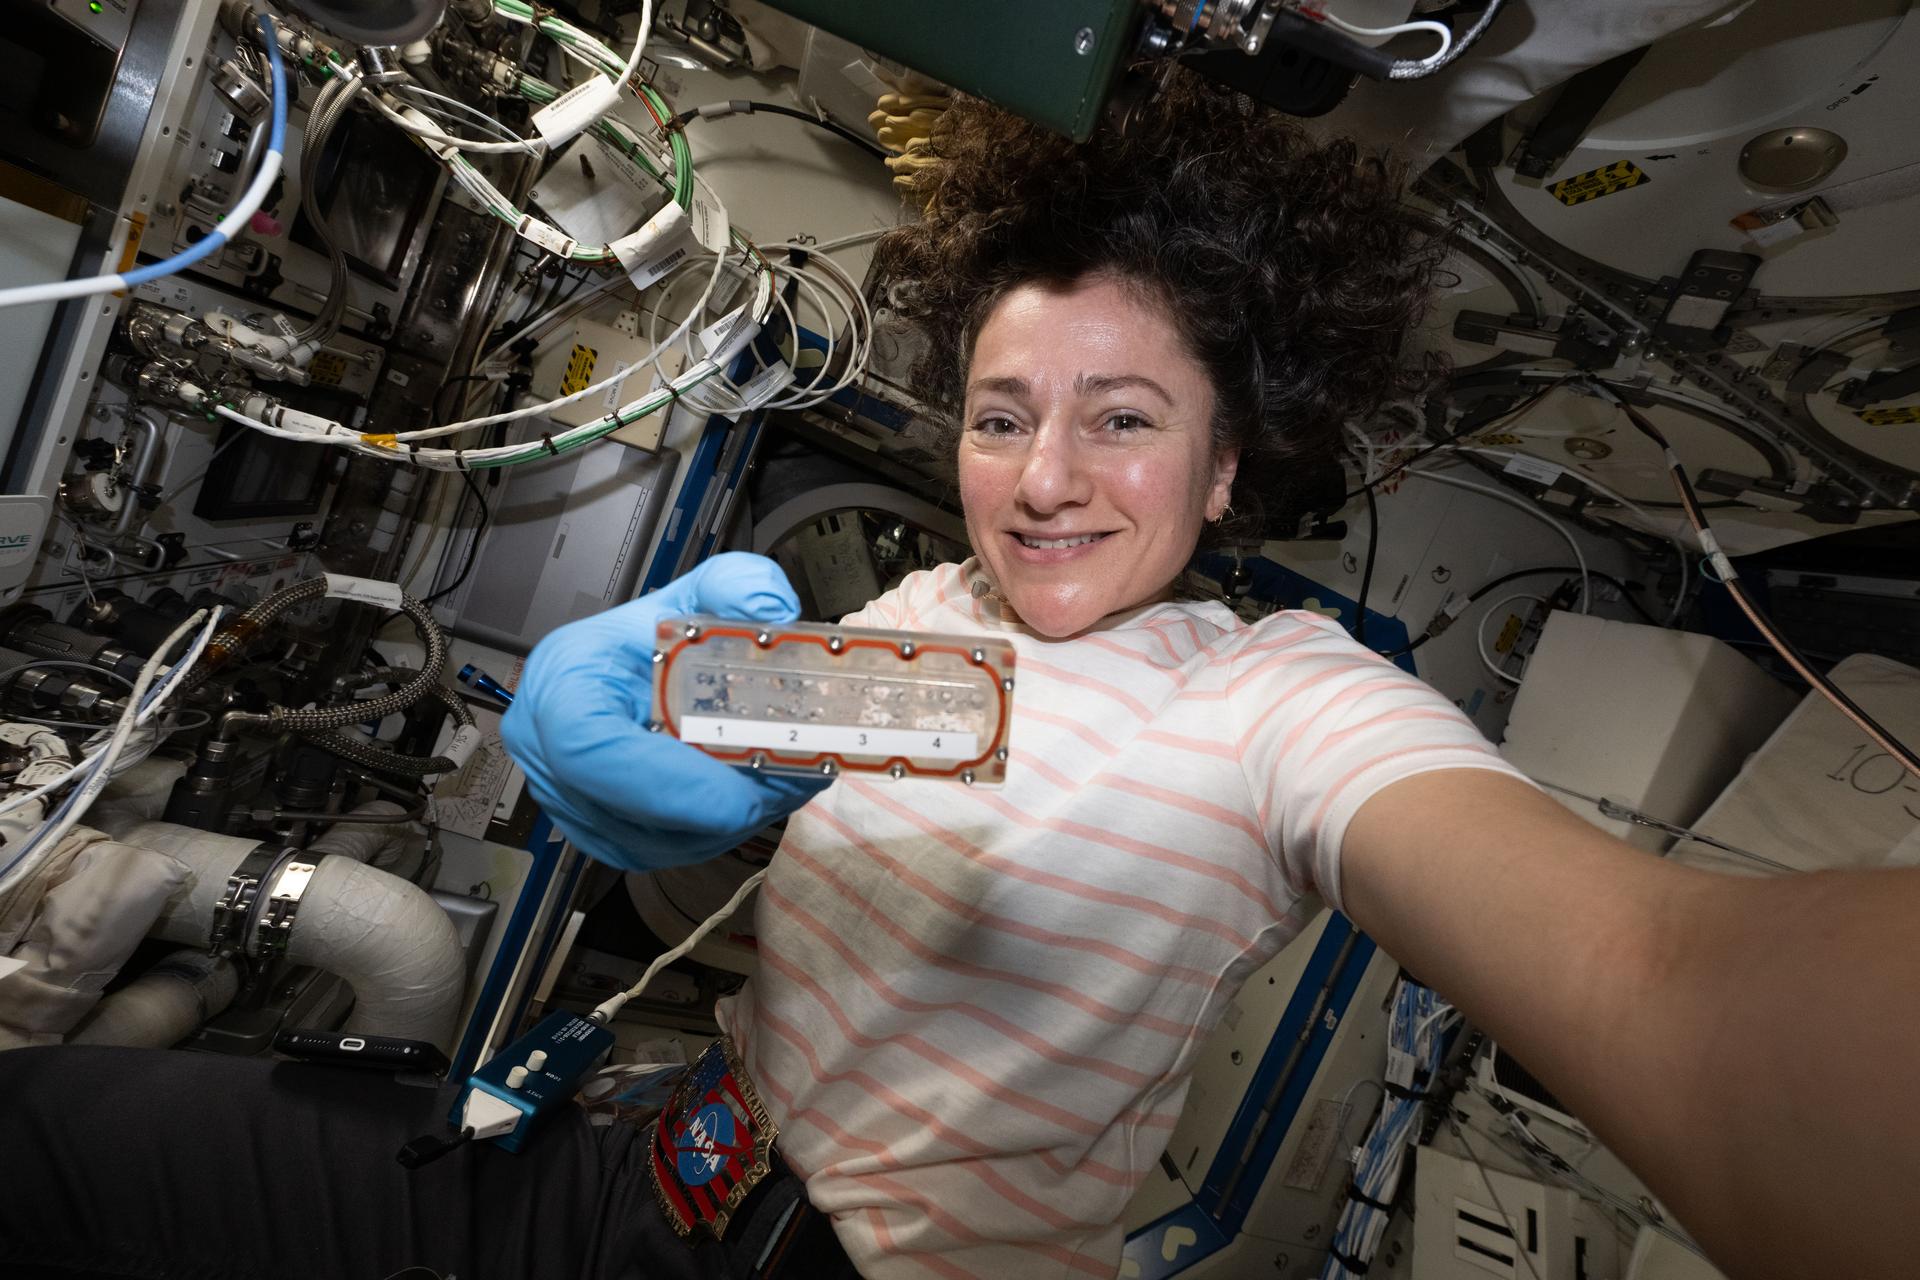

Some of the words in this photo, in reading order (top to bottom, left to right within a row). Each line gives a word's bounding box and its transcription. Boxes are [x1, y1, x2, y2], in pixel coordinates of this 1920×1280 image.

[716, 725, 723, 737] 1
[789, 730, 798, 742] 2
[859, 734, 867, 746] 3
[932, 737, 941, 749] 4
[744, 1084, 777, 1136] STATION
[688, 1116, 721, 1174] NASA
